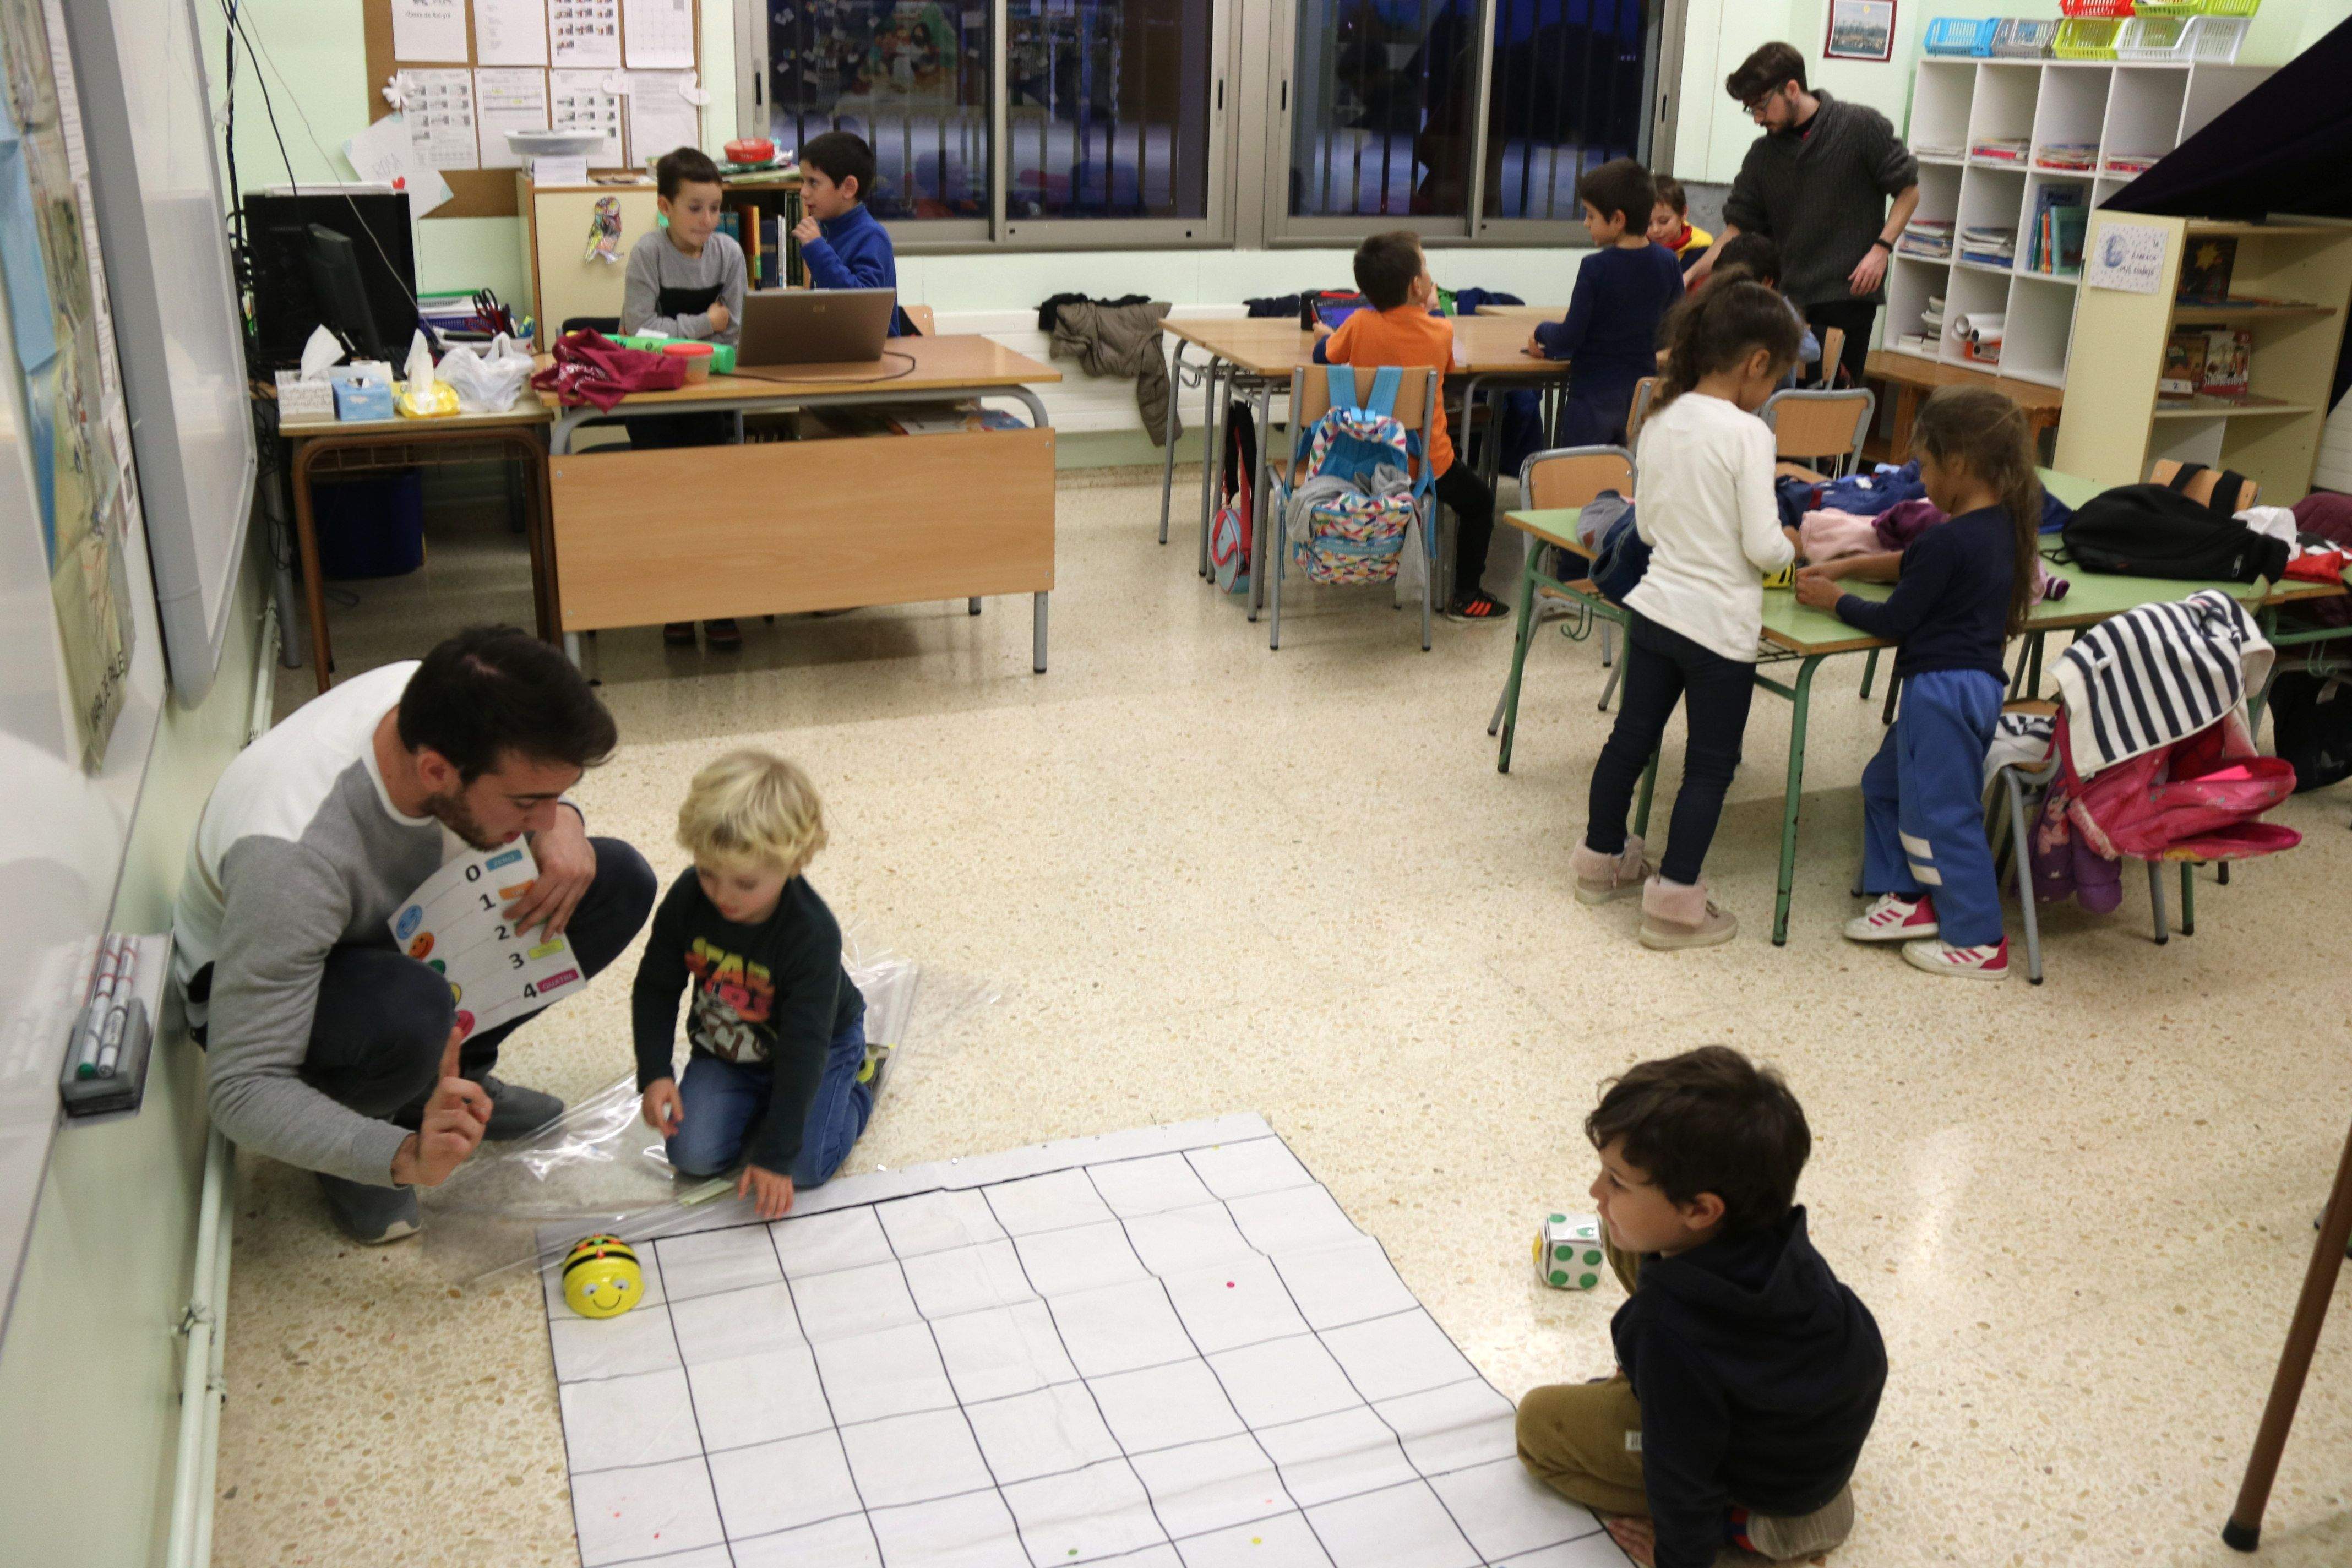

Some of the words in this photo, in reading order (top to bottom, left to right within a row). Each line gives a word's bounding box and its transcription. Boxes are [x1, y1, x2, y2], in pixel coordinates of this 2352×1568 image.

[465, 864, 480, 882] 0
[478, 893, 496, 912] 1
[494, 924, 510, 941] 2
[509, 953, 524, 970] 3
[523, 982, 537, 999] 4
[542, 972, 574, 990] QUATRE
